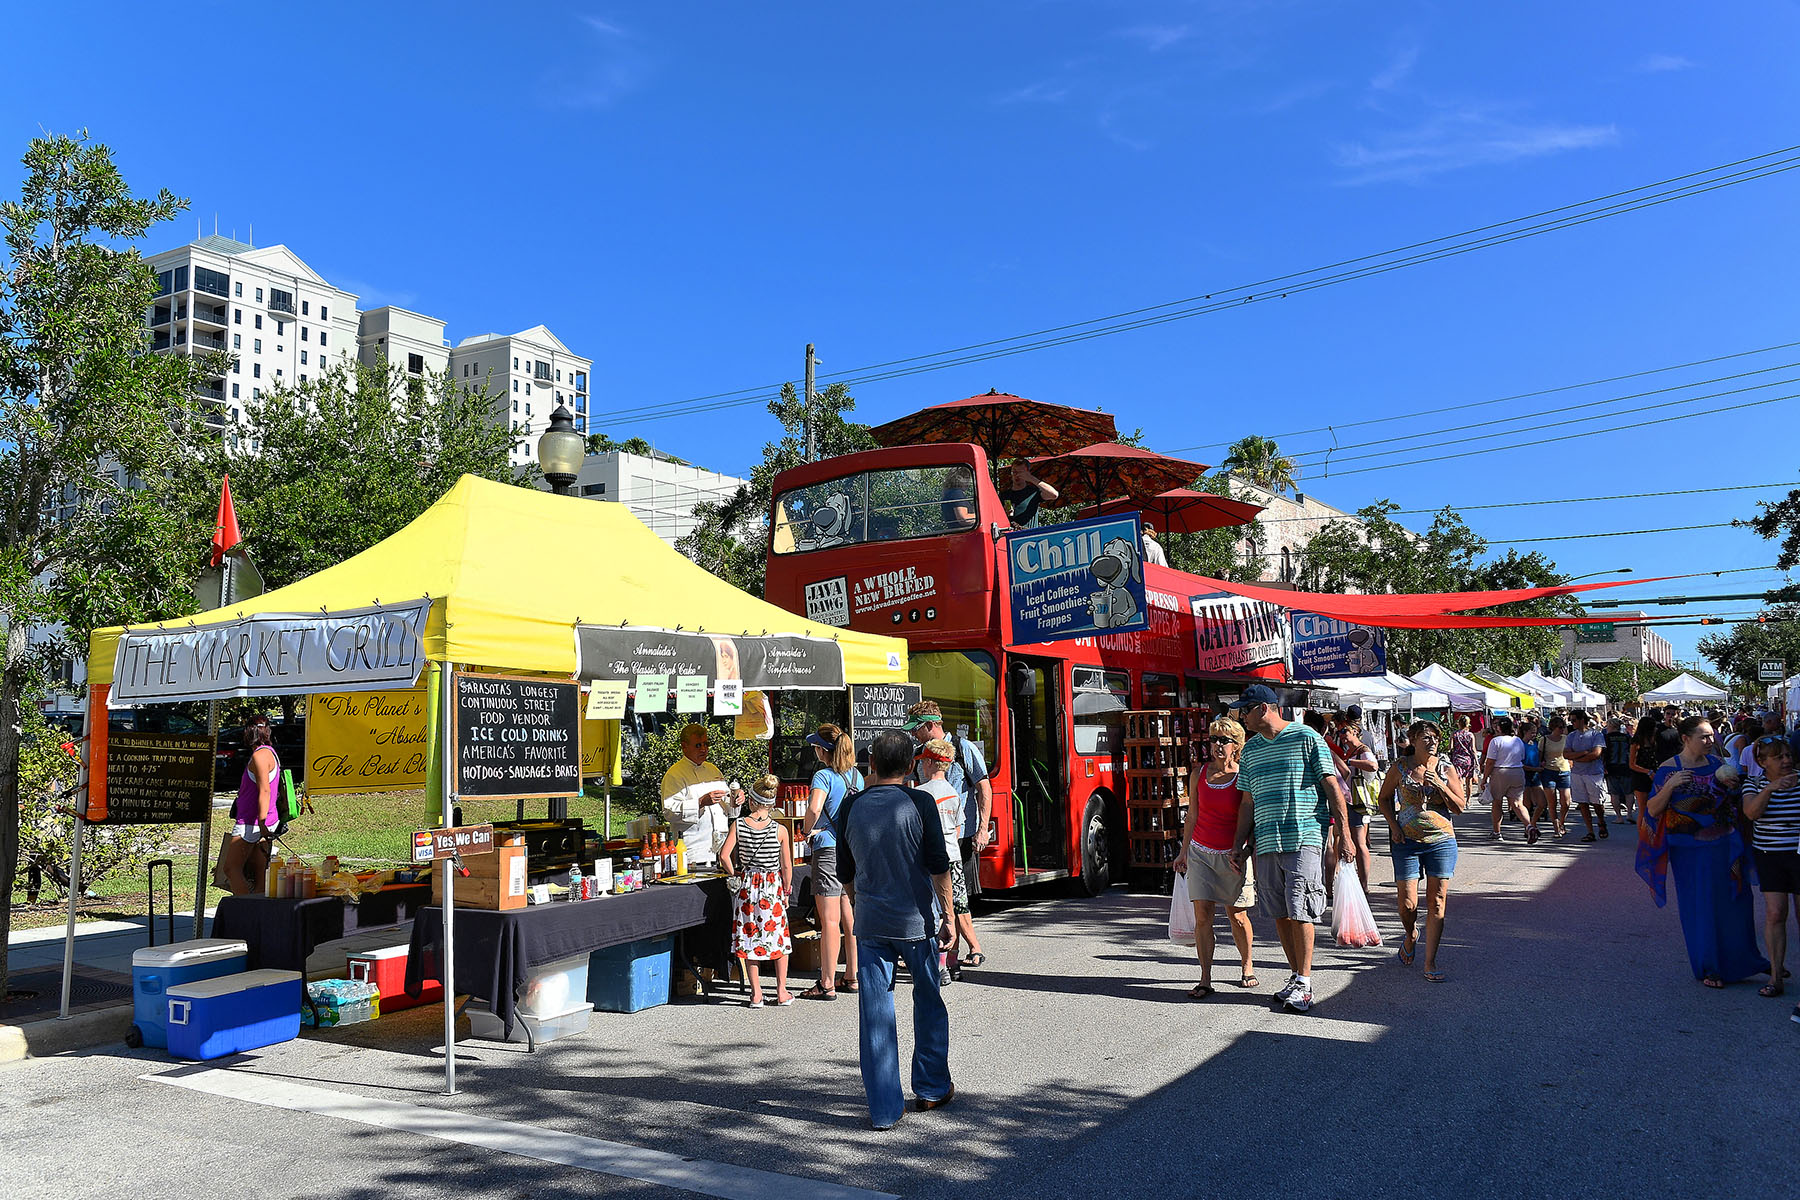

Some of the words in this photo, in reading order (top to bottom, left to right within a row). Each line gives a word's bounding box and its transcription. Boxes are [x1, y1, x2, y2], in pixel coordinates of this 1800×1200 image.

[1016, 531, 1101, 573] Chill
[854, 582, 862, 594] A
[863, 566, 917, 591] WHOLE
[807, 580, 843, 600] JAVA
[855, 591, 880, 606] NEW
[883, 575, 935, 600] BREED
[1026, 593, 1045, 606] Iced
[1047, 585, 1080, 602] Coffees
[809, 596, 844, 614] DAWG
[855, 589, 937, 614] www.javadawgcoffee.net
[1020, 607, 1040, 620] Fruit
[1042, 596, 1088, 616] Smoothies
[1037, 613, 1072, 629] Frappes
[1200, 603, 1244, 652] JAVA
[129, 641, 181, 687] THE
[189, 627, 317, 683] MARKET
[325, 619, 410, 673] GRILL
[1204, 653, 1227, 670] CRAFT
[1228, 647, 1257, 664] ROASTED
[1258, 642, 1280, 659] COFFEE
[1302, 648, 1316, 657] Iced
[1317, 645, 1341, 654] Coffees
[631, 661, 657, 675] Classic
[658, 661, 677, 675] Crab
[1298, 657, 1313, 665] Fruit
[1310, 662, 1335, 671] Frappes
[1761, 662, 1783, 670] ATM
[460, 681, 512, 696] SARASOTA'S
[520, 685, 559, 699] LONGEST
[864, 686, 905, 702] SARASOTA'S
[363, 695, 422, 717] Planet's
[461, 696, 518, 710] CONTINUOUS
[524, 699, 556, 712] STREET
[854, 702, 869, 717] BEST
[872, 702, 889, 717] CRAB
[889, 703, 906, 718] CAKE
[480, 712, 505, 725] FOOD
[512, 713, 551, 726] VENDOR
[471, 726, 494, 741] ICE
[501, 728, 528, 742] COLD
[533, 729, 568, 742] DRINKS
[155, 740, 174, 748] PLATE
[462, 744, 516, 760] AMERICA'S
[524, 746, 567, 760] FAVORITE
[116, 753, 122, 761] A
[123, 753, 150, 761] COOKING
[151, 754, 168, 762] TRAY
[178, 756, 195, 764] OVEN
[312, 754, 355, 777] The
[359, 754, 400, 777] Best
[129, 764, 138, 773] TO
[124, 776, 144, 785] CRAB
[145, 777, 164, 787] CAKE
[109, 786, 138, 796] UNWRAP
[160, 789, 177, 799] COOK
[178, 790, 191, 800] FOR
[110, 797, 119, 806] 10
[122, 798, 151, 808] MINUTES
[153, 799, 171, 808] EACH
[175, 801, 190, 810] SIDE
[455, 833, 471, 846] We
[472, 830, 490, 844] Can
[417, 848, 433, 857] VISA
